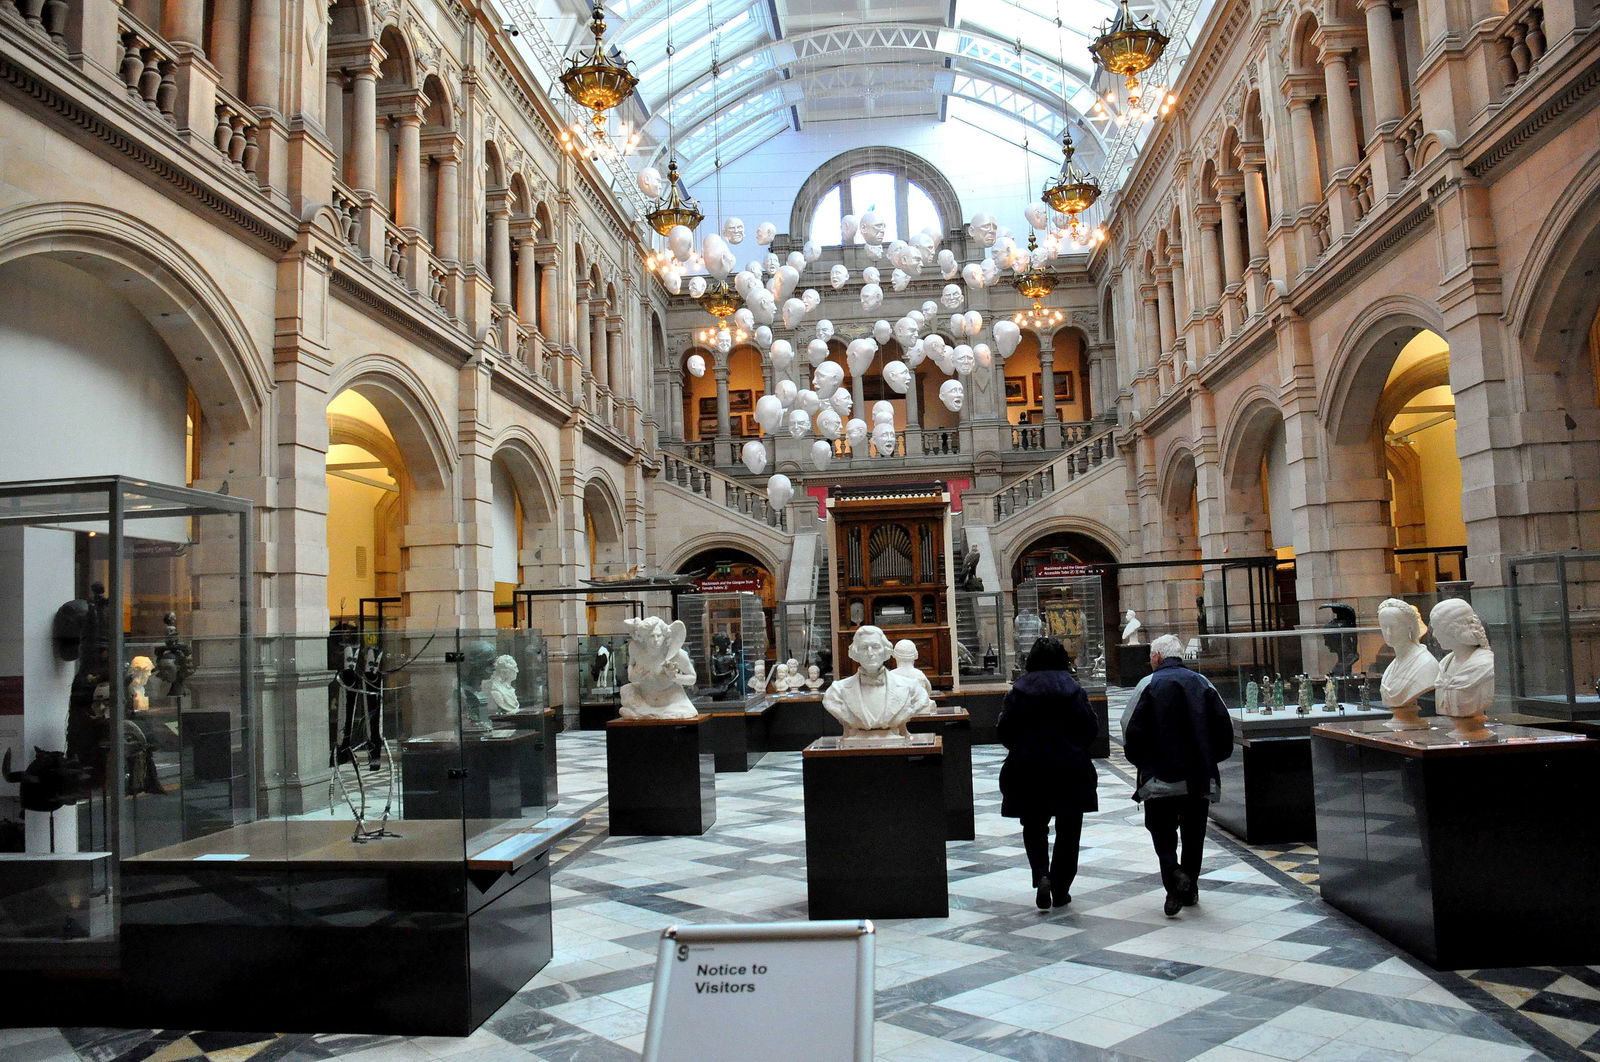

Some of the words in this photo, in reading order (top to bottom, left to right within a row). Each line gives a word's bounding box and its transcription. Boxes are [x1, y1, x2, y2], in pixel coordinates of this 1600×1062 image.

[696, 964, 747, 976] Notice
[752, 964, 768, 975] to
[695, 981, 756, 994] Visitors
